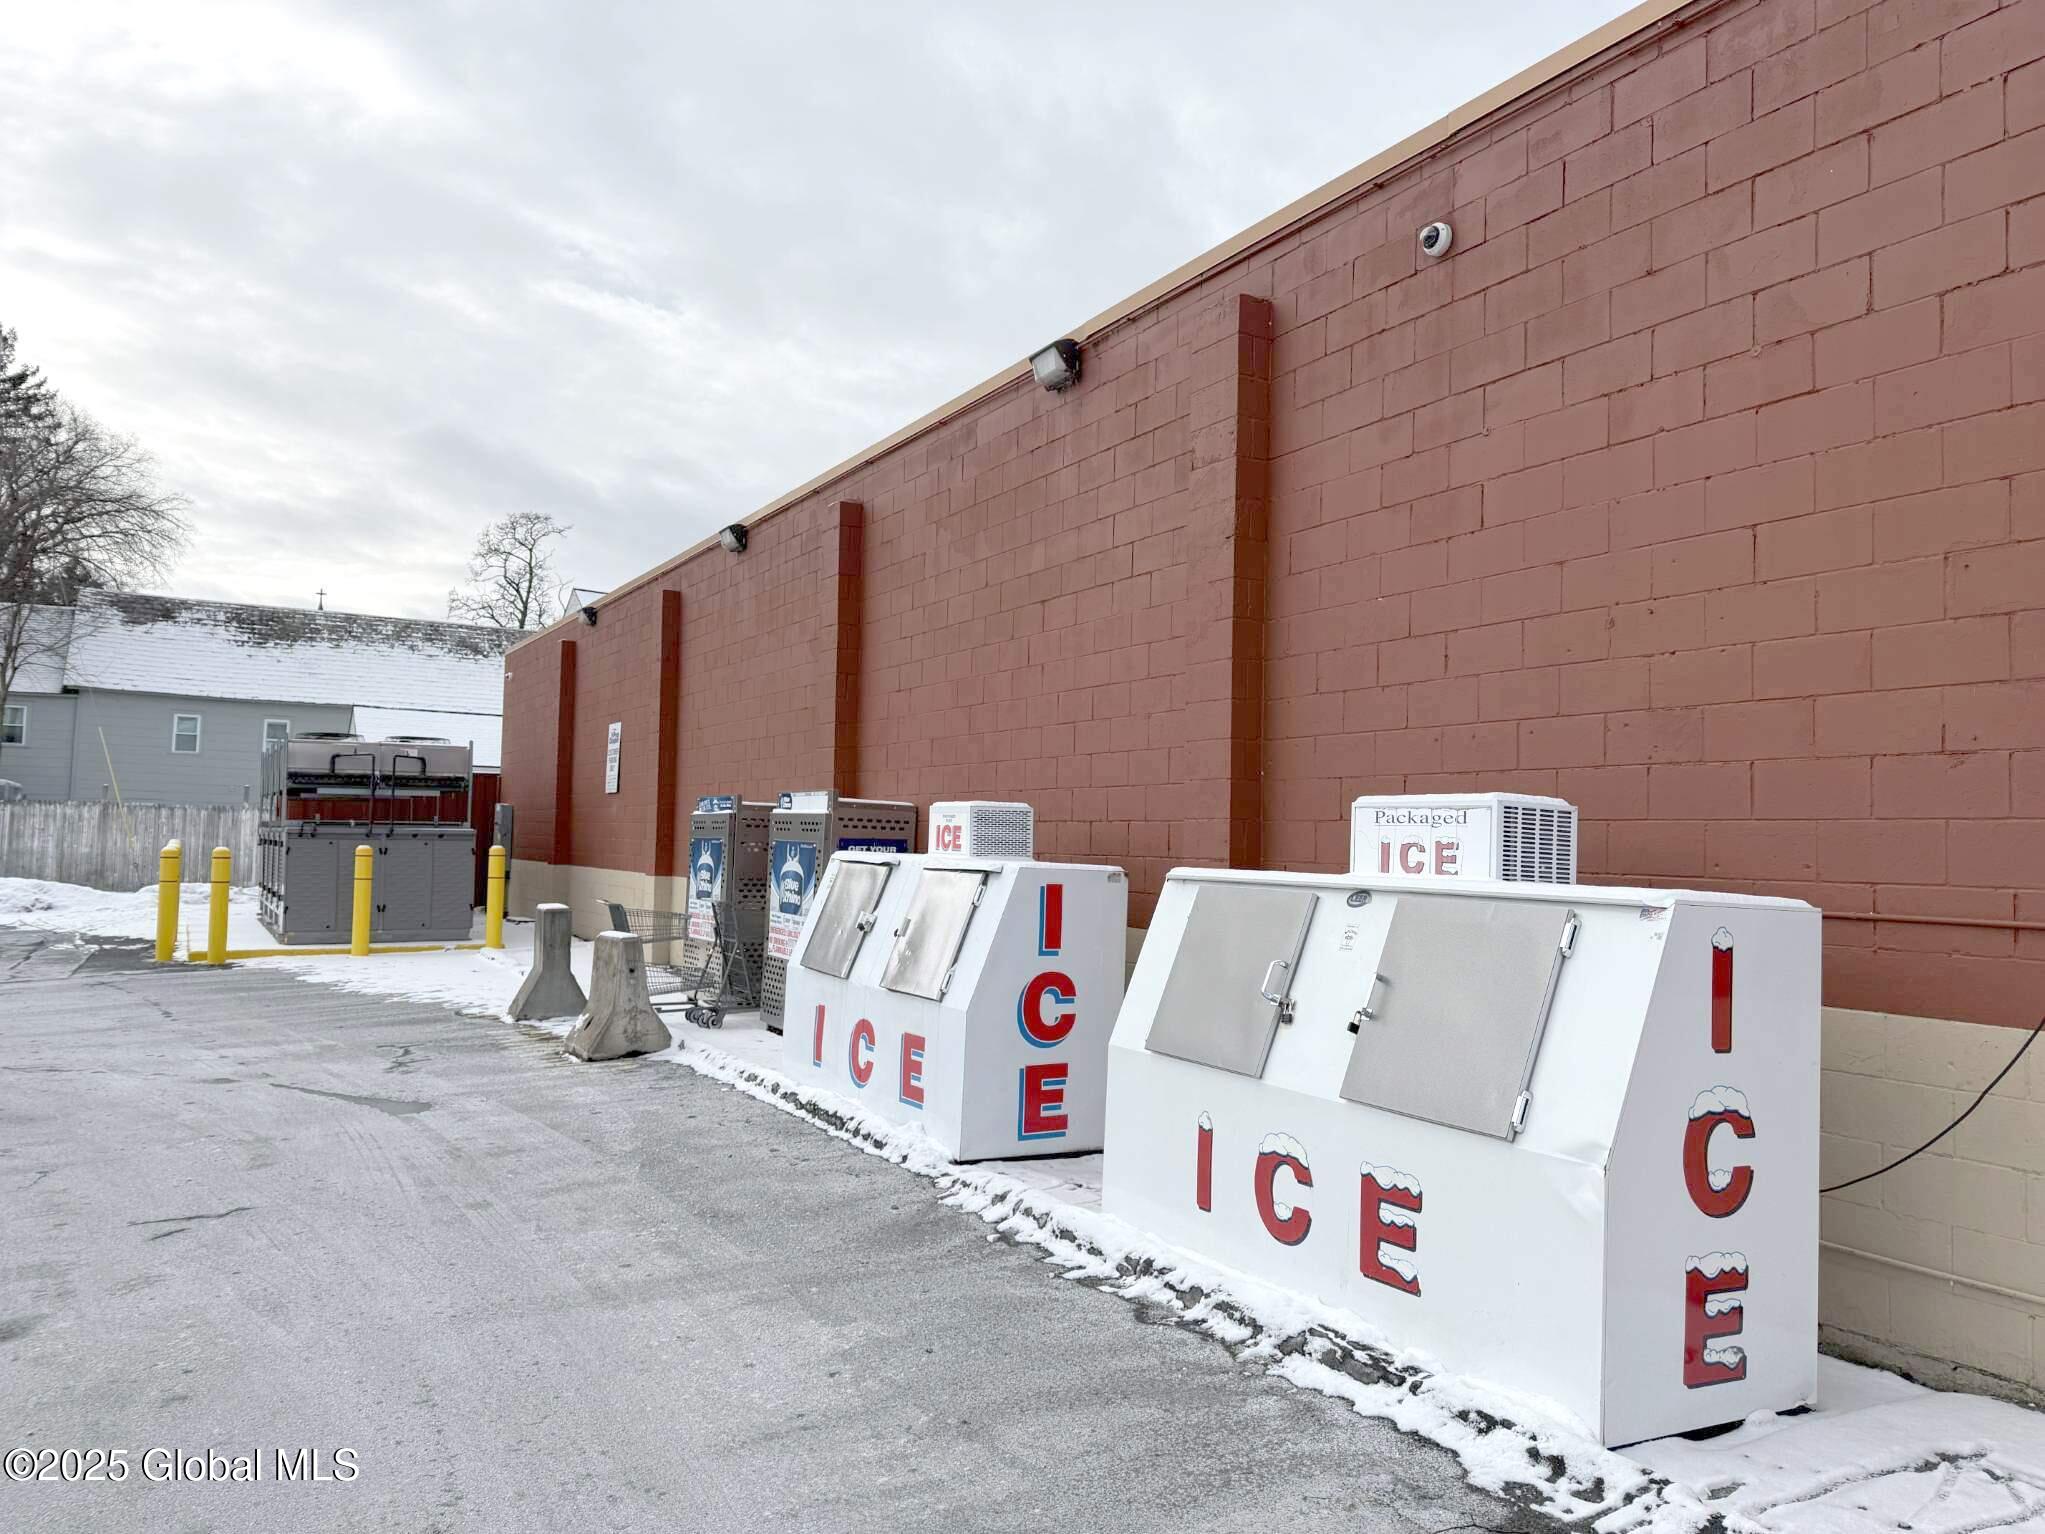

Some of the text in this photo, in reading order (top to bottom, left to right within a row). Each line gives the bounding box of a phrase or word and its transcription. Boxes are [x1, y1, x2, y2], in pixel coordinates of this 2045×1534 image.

[936, 824, 962, 851] ICE
[1375, 810, 1468, 829] Packaged
[1380, 836, 1460, 876] ICE
[812, 1004, 926, 1110] ICE
[1016, 882, 1077, 1141] ICE
[1196, 1110, 1424, 1298] ICE
[1683, 926, 1756, 1390] ICE
